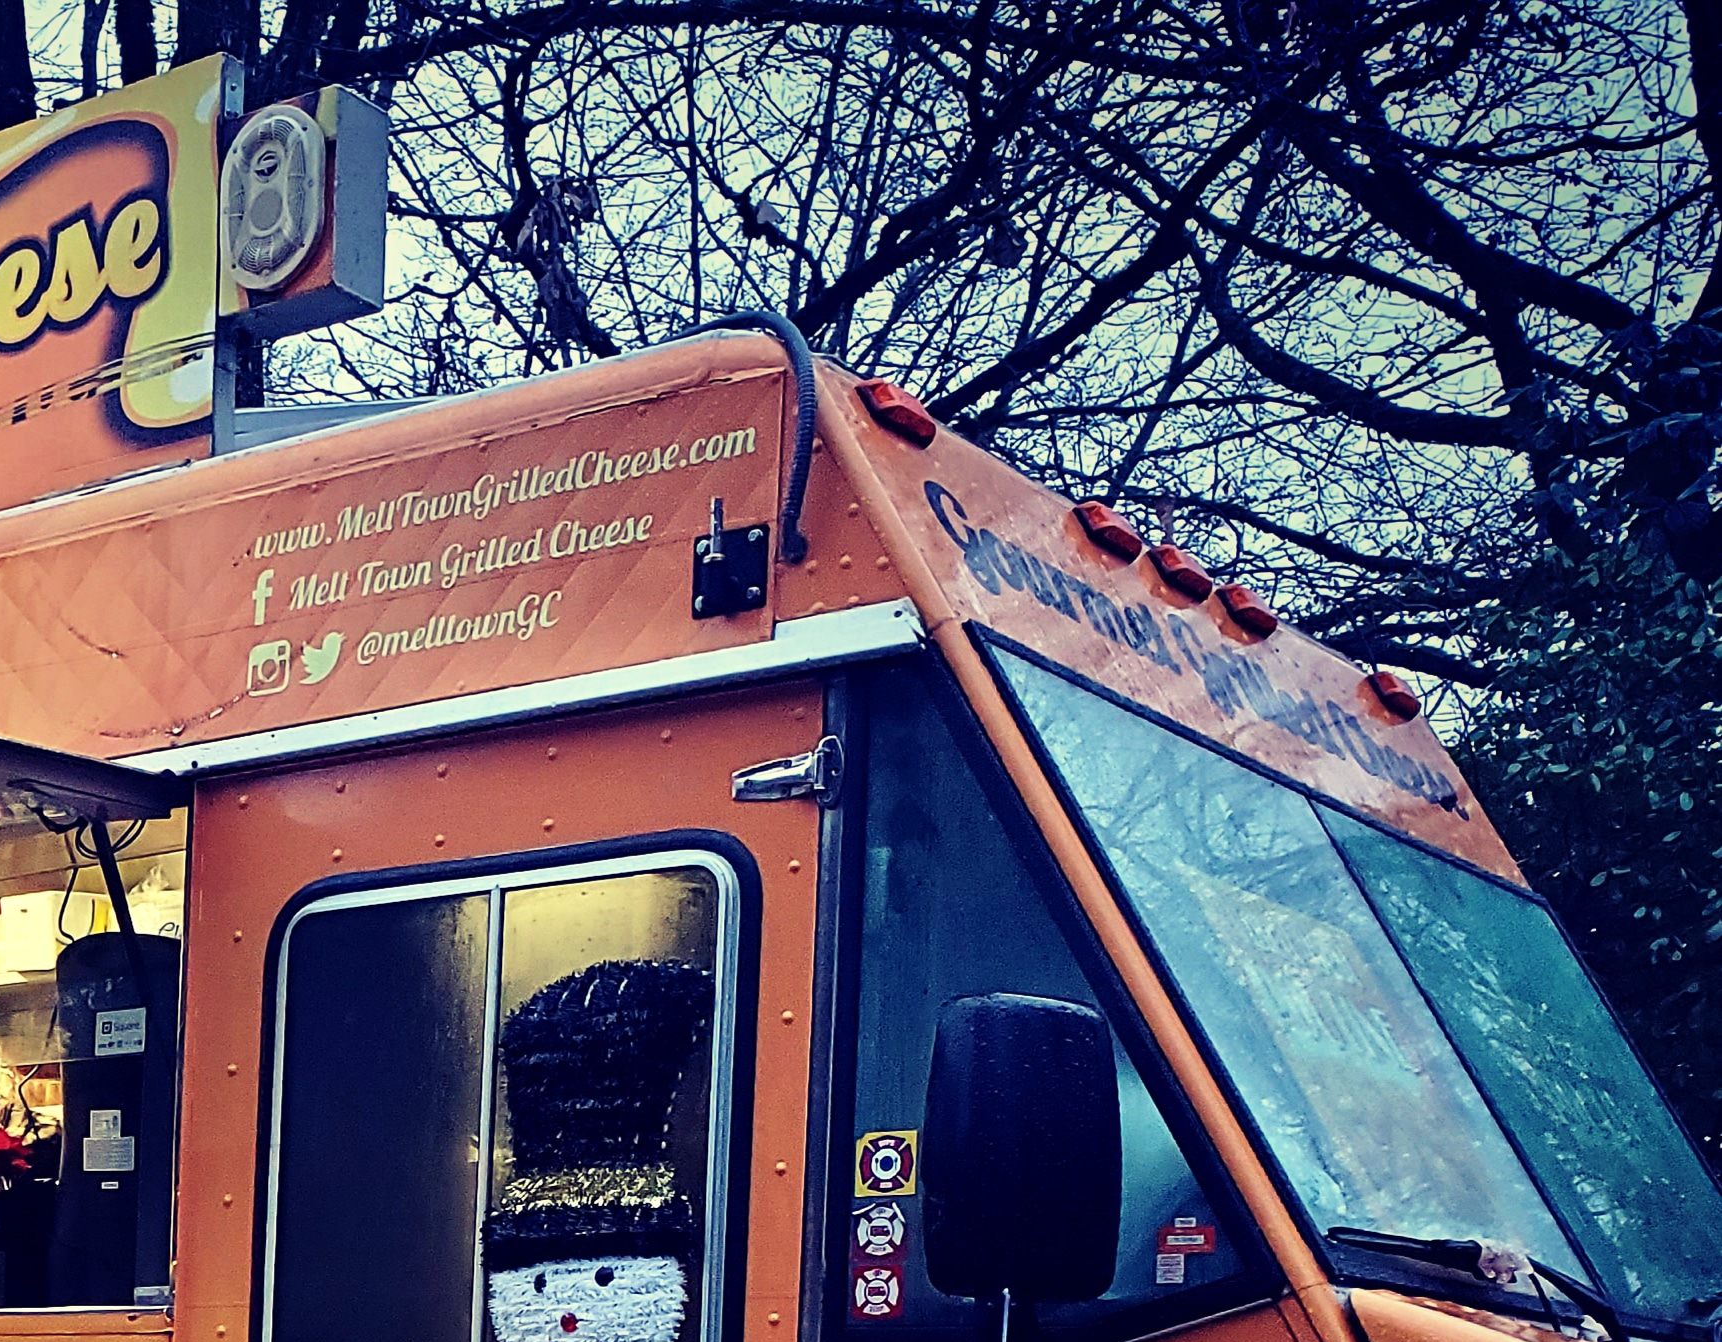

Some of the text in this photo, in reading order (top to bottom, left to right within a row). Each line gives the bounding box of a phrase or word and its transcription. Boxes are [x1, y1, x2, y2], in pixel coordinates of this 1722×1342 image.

[252, 426, 758, 560] www.MeltTownGrilledCheese.com
[288, 561, 348, 612] Melt
[357, 560, 433, 597] Town
[439, 523, 542, 590] Grilled
[549, 512, 654, 559] Cheese
[357, 590, 563, 666] @melttownGC
